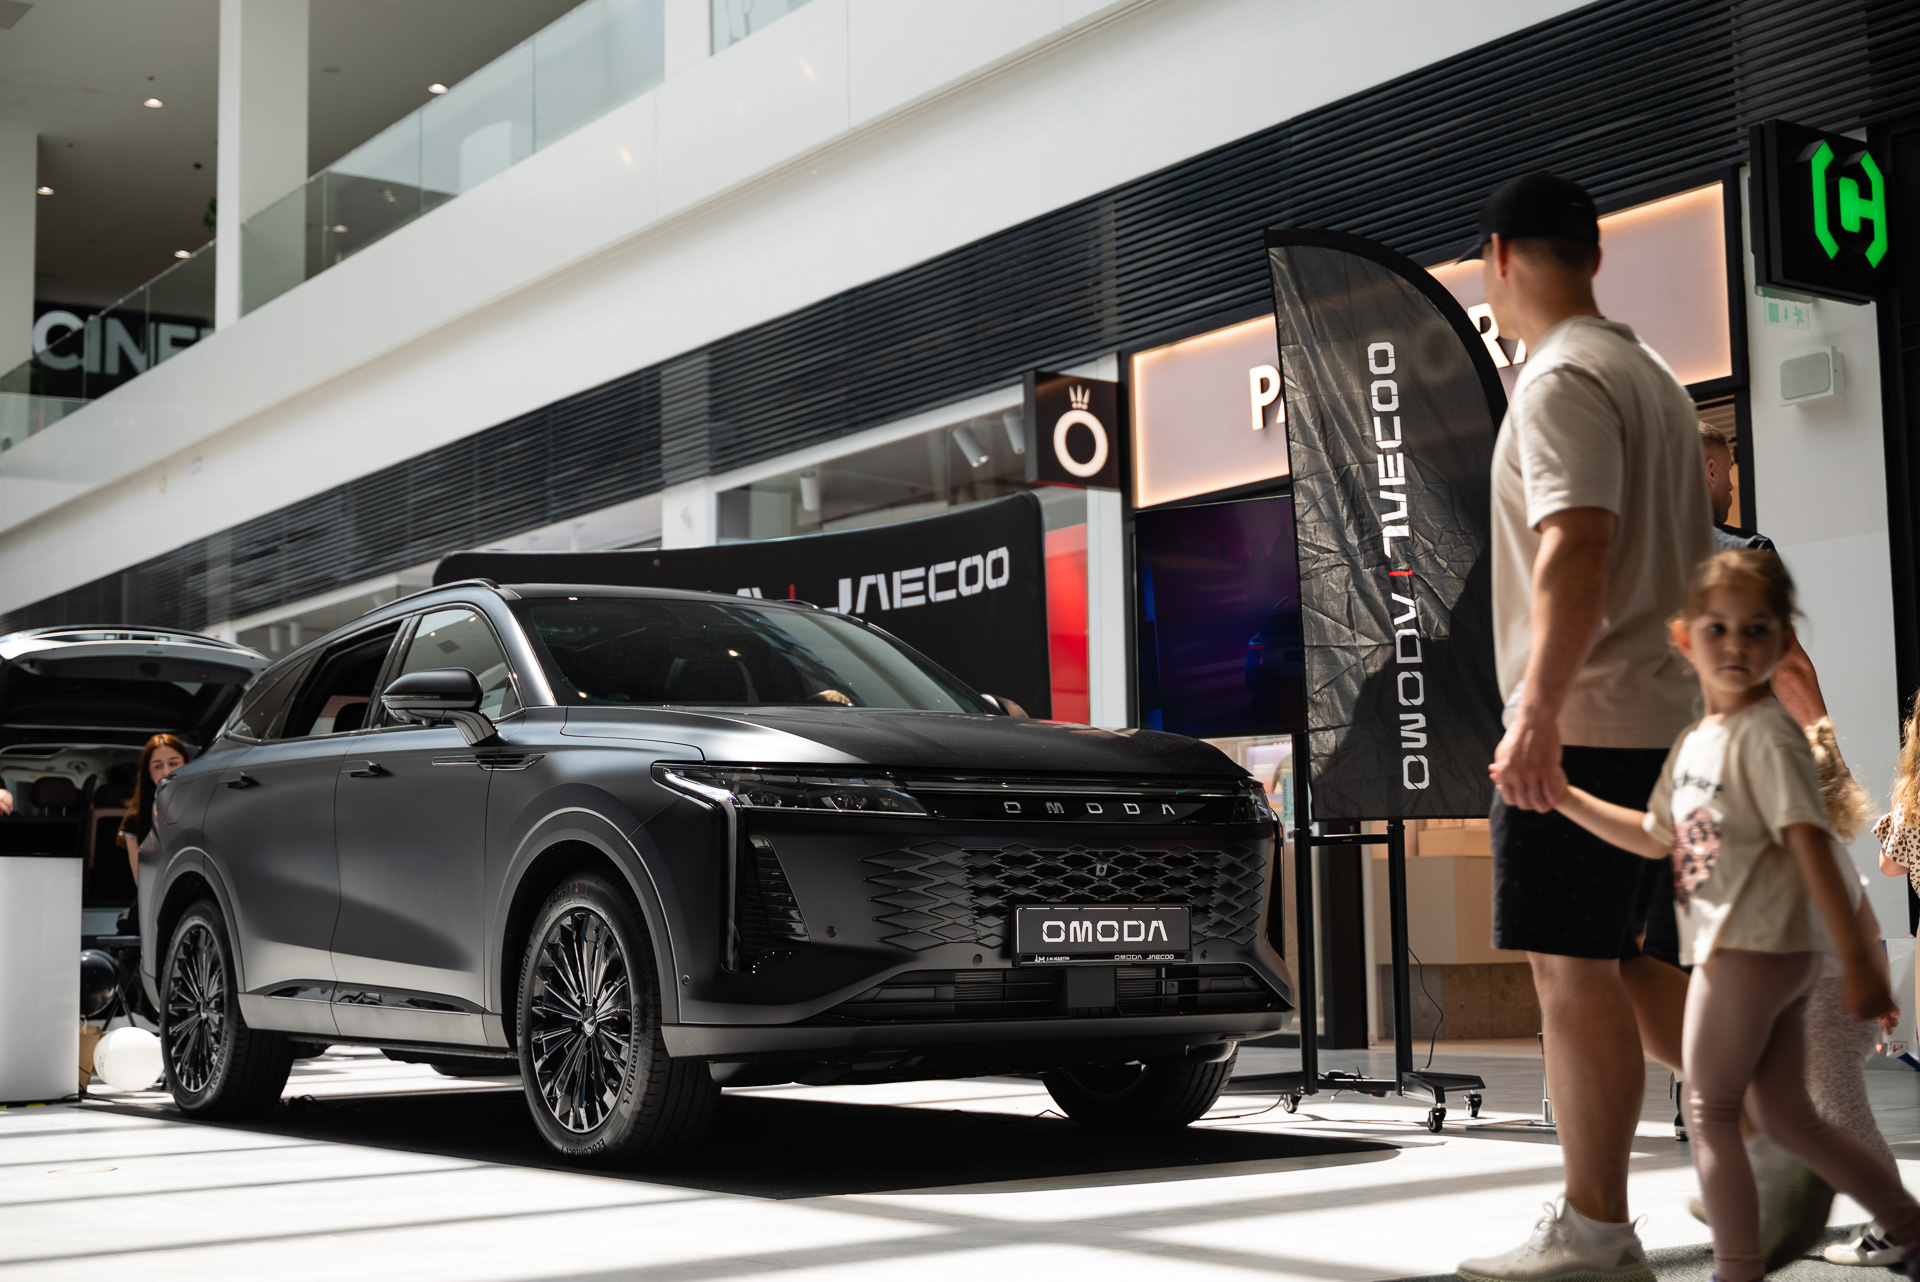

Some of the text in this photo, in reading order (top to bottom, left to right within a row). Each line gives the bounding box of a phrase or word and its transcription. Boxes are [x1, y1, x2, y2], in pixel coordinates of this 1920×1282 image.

[32, 310, 215, 375] CINE
[822, 546, 1010, 615] JAECOO
[1367, 341, 1430, 790] OMODA JAECOO
[1003, 801, 1175, 815] OMODA
[1042, 920, 1168, 942] OMODA
[625, 1002, 641, 1096] Continental
